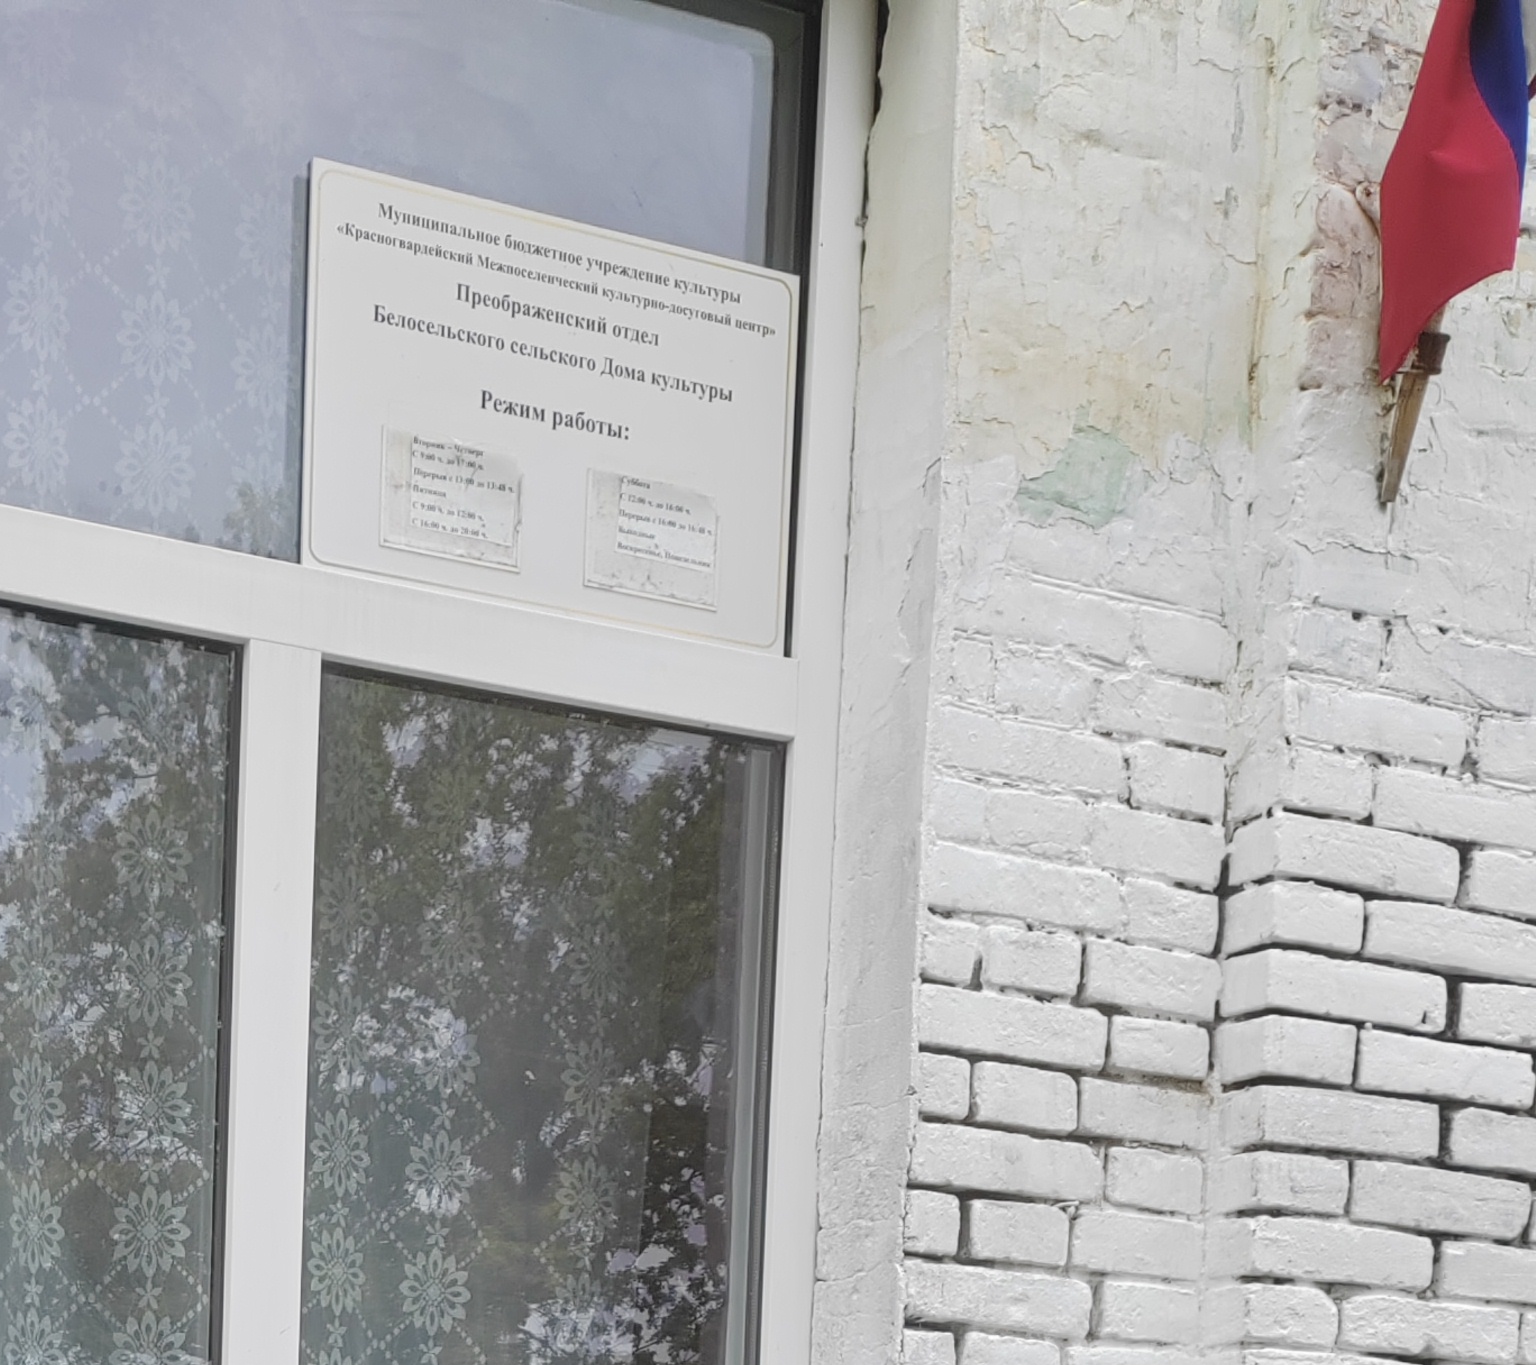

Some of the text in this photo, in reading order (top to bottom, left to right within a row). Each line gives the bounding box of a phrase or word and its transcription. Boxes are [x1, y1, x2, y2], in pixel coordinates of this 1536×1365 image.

[337, 222, 776, 338] «Красногвардейский Межпоселенческий культурно-досуговый центр»
[378, 203, 742, 304] Муниципальное бюджетное учреждение культуры
[373, 304, 733, 403] Белосельского сельского Дома культуры
[456, 283, 660, 347] Преображенский отдел
[480, 389, 630, 440] Режим работы:
